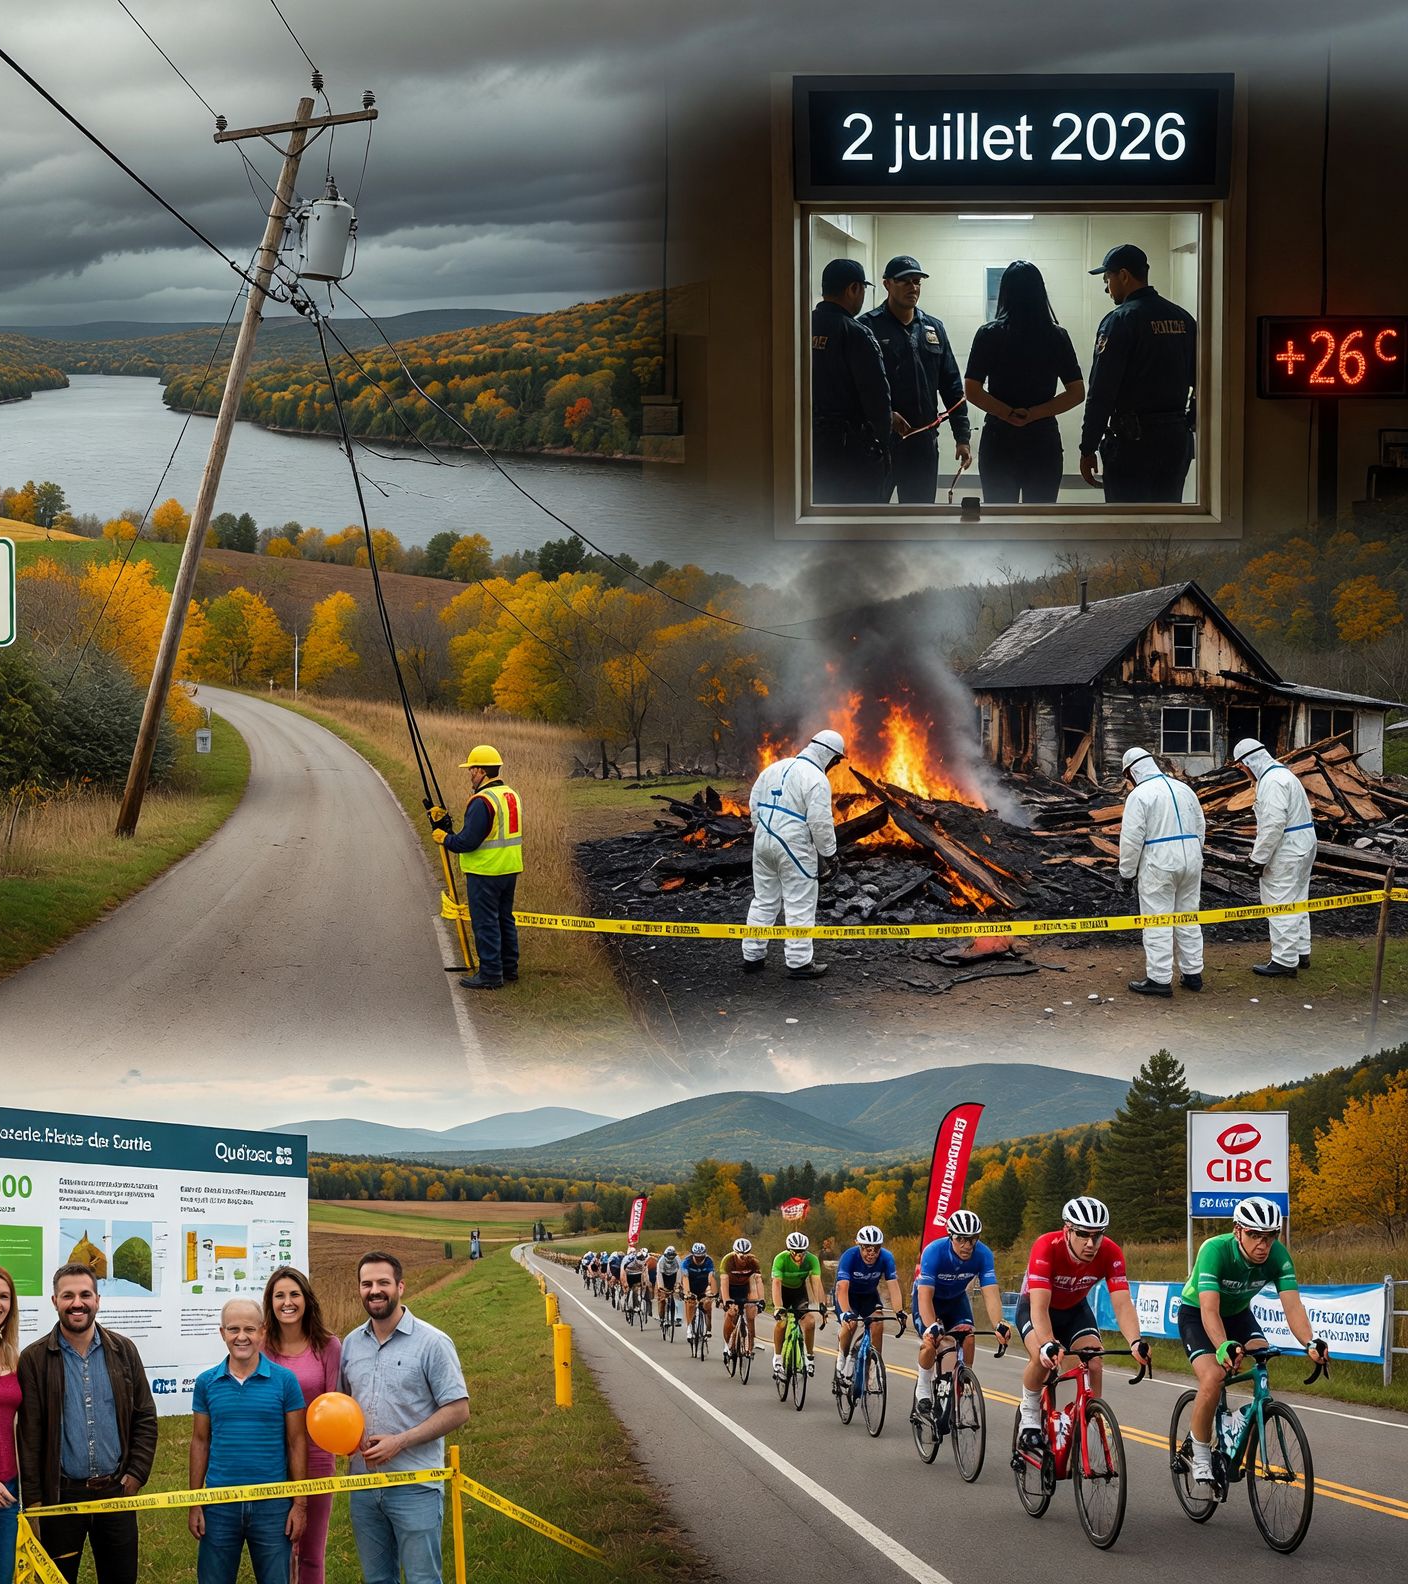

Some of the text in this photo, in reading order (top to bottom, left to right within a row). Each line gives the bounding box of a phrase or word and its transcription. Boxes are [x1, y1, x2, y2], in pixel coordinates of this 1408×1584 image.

[841, 112, 1186, 173] 2 juillet 2026
[1206, 1158, 1272, 1183] CIBC
